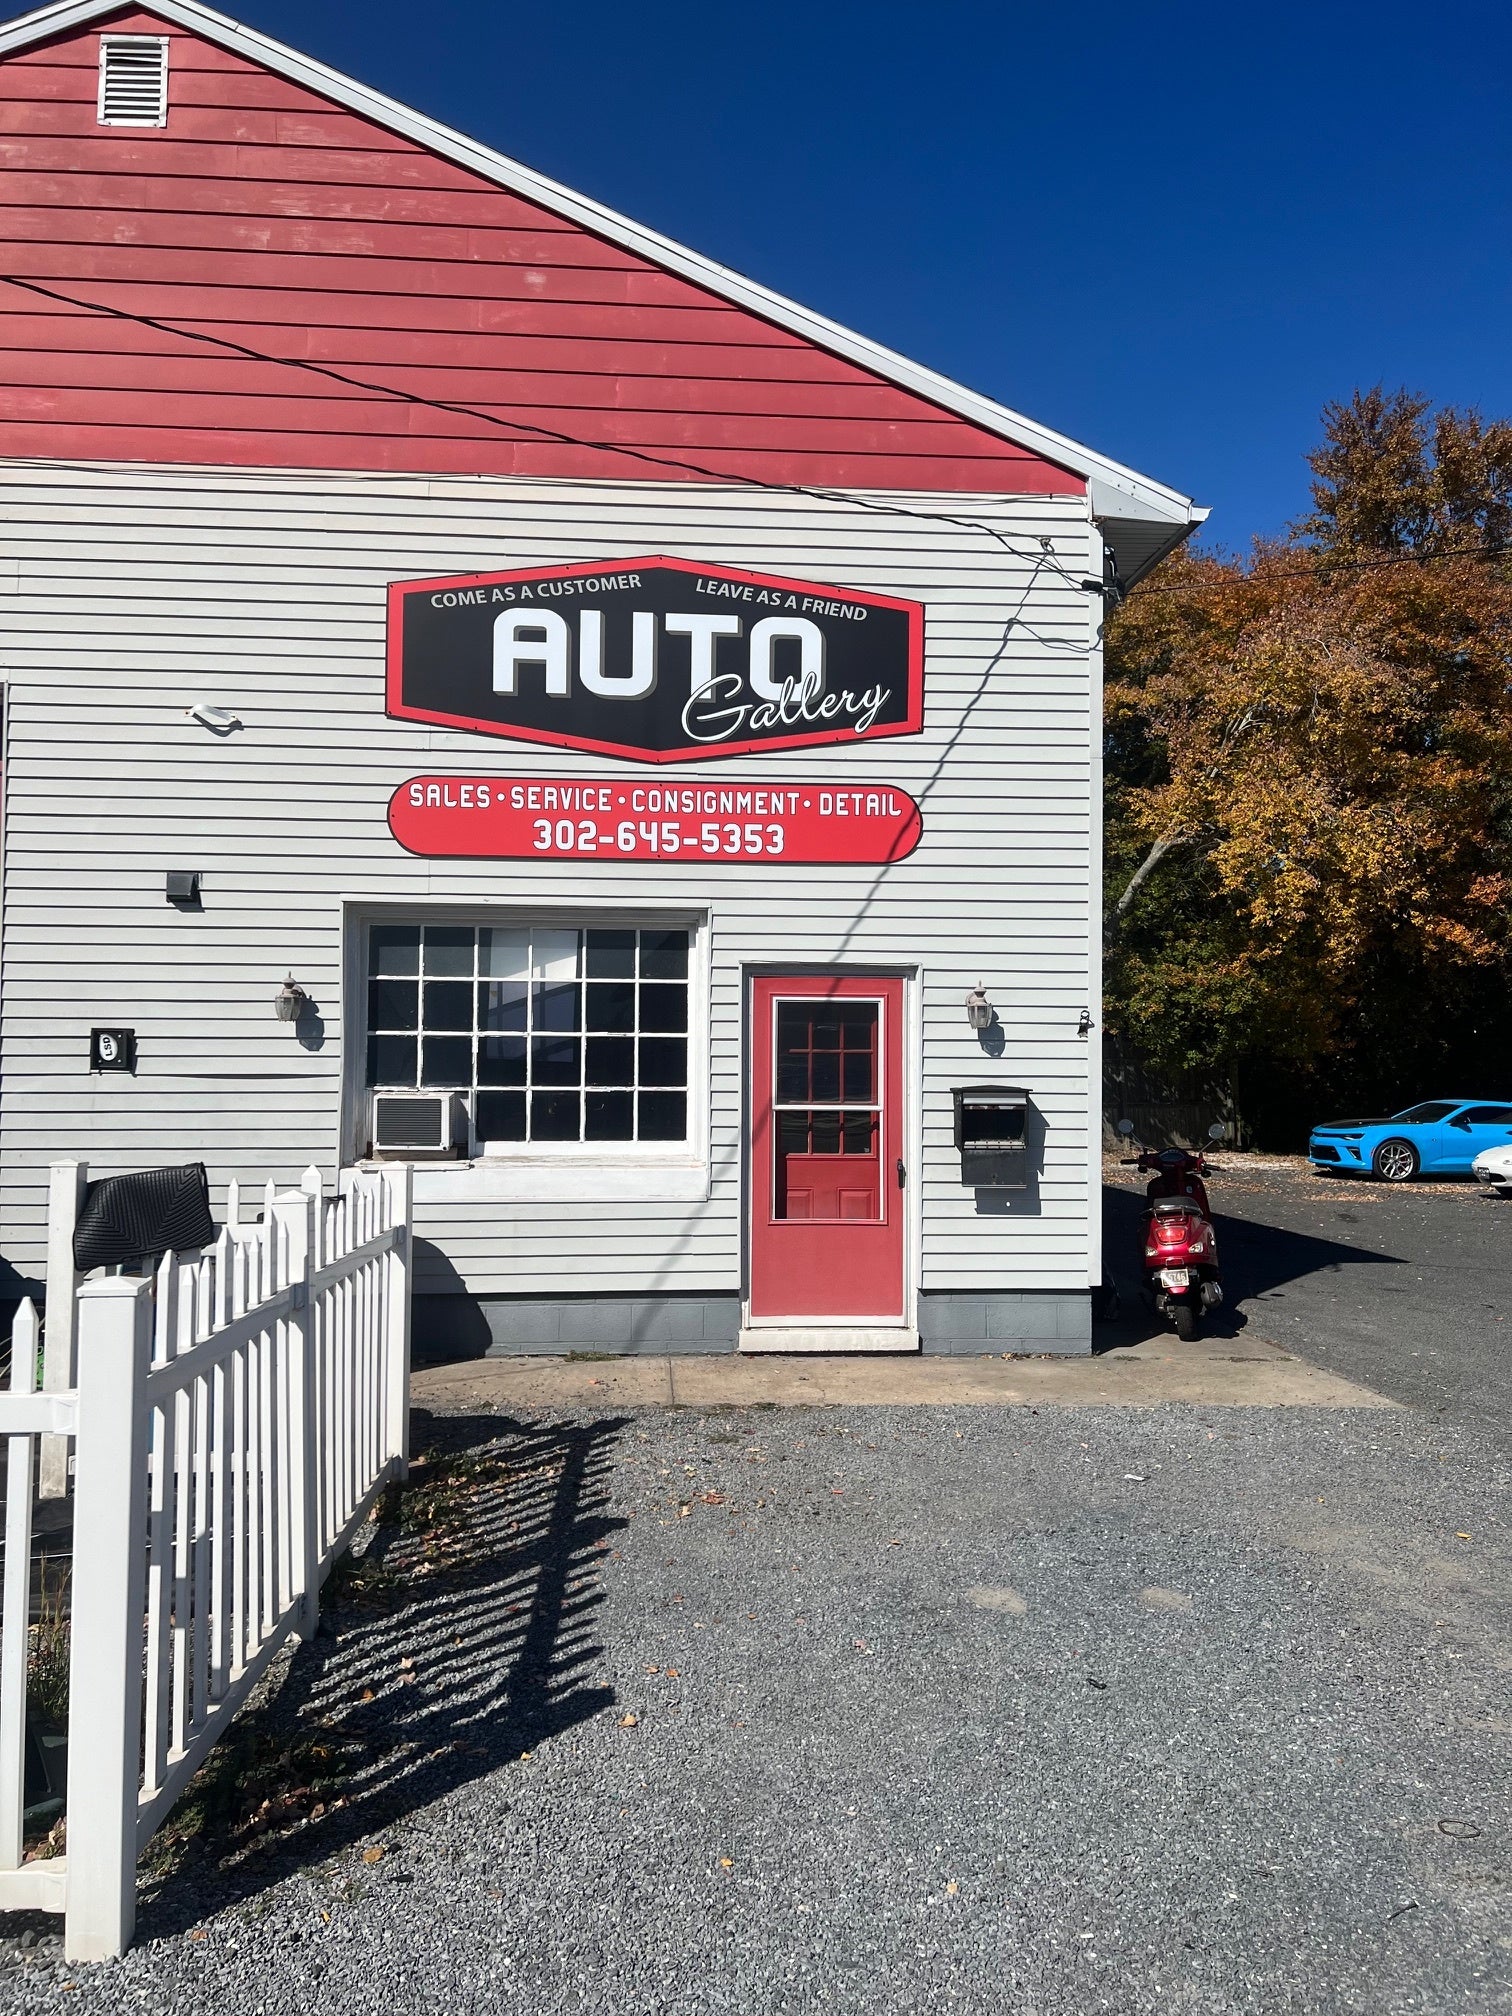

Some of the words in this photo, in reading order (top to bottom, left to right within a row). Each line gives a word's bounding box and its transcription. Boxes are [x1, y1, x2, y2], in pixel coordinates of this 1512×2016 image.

[430, 589, 487, 608] COME
[491, 586, 516, 603] AS
[520, 585, 534, 600] A
[537, 574, 642, 598] CUSTOMER
[695, 578, 754, 602] LEAVE
[756, 590, 782, 606] AS
[784, 595, 797, 610] A
[801, 597, 868, 621] FRIEND
[493, 607, 827, 705] AUTO
[681, 671, 891, 742] Gallery
[409, 783, 491, 808] SALES
[510, 785, 613, 811] SERVICE
[631, 789, 800, 815] CONSIGNMENT
[819, 792, 902, 816] DETAIL
[532, 818, 785, 854] 302-645-5353
